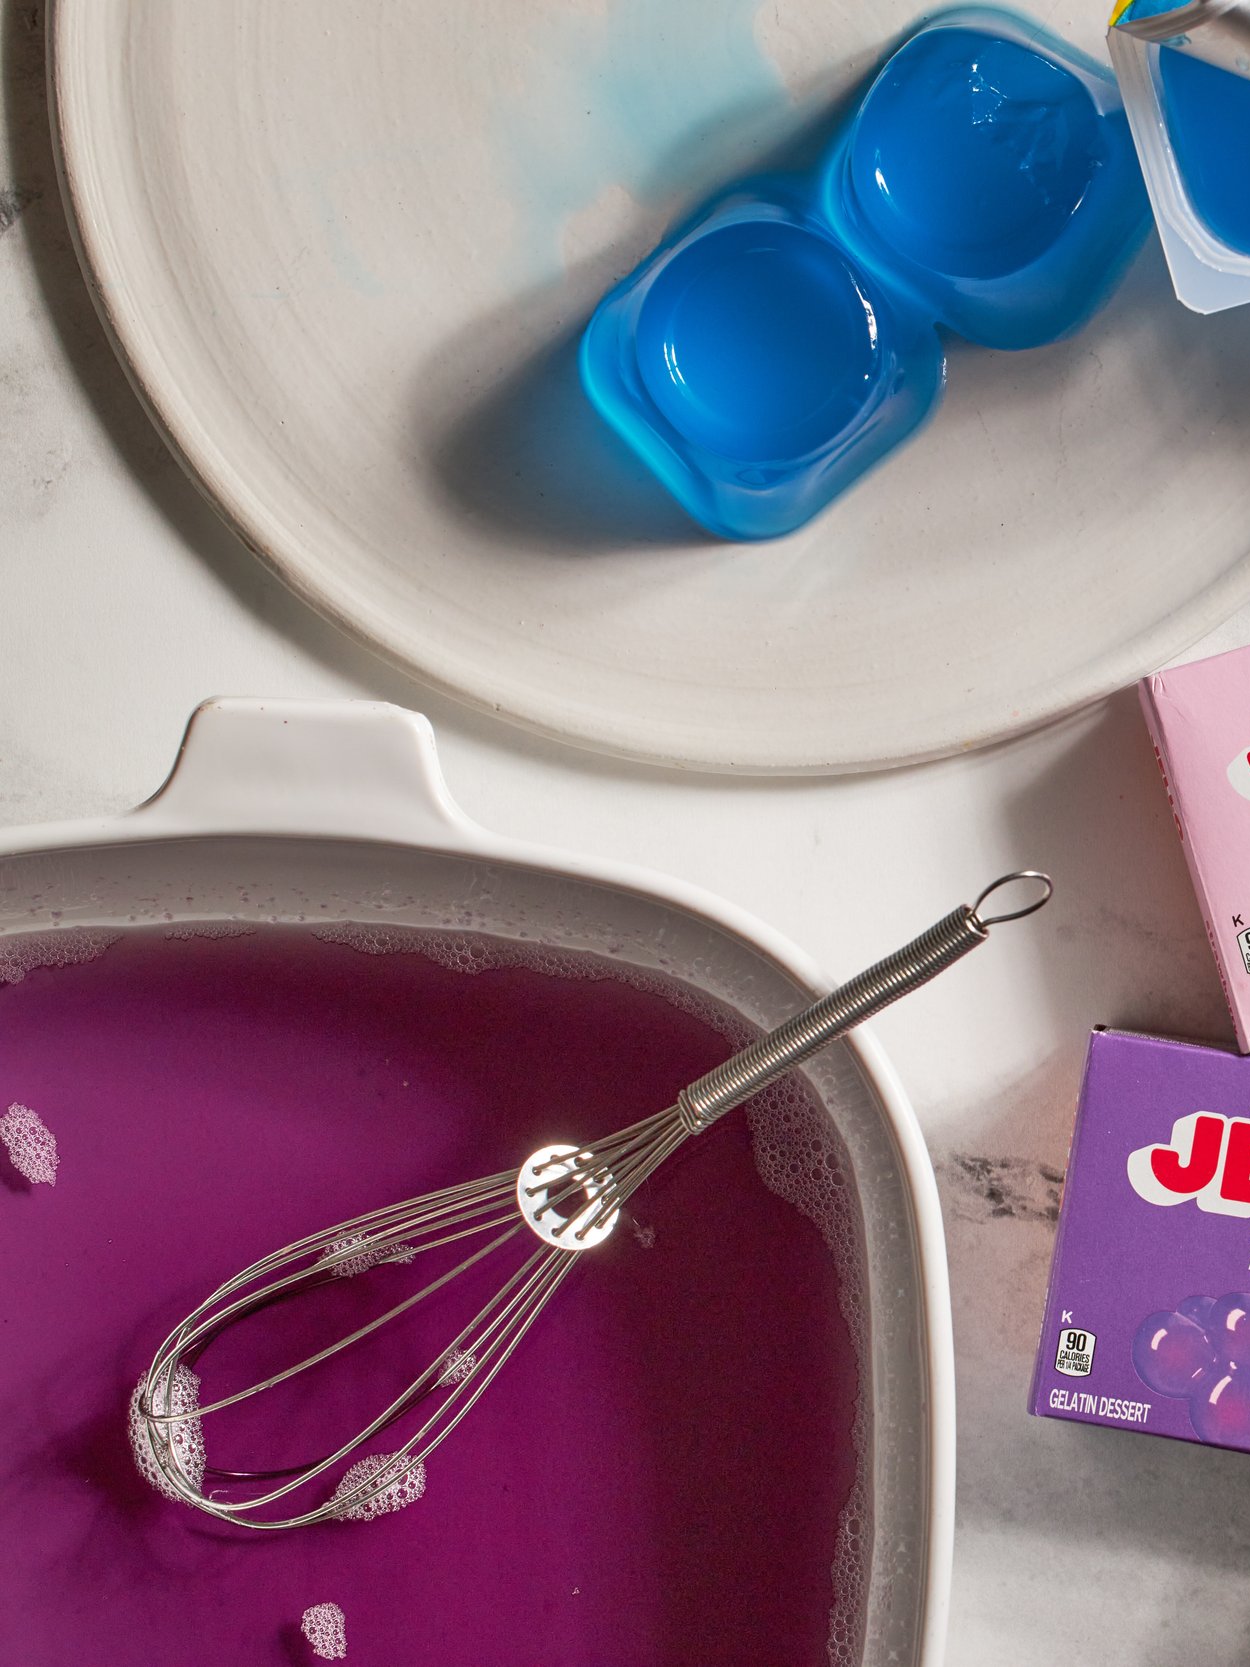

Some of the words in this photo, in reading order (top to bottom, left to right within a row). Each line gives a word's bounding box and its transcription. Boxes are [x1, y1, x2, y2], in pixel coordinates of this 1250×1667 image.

[1232, 914, 1244, 927] K
[1061, 1310, 1073, 1324] K
[1066, 1331, 1087, 1352] 90
[1059, 1350, 1090, 1364] CALORIES
[1057, 1359, 1065, 1368] PER
[1072, 1361, 1090, 1373] PACKAGE
[1049, 1388, 1098, 1415] GELATIN
[1098, 1397, 1152, 1424] DESSERT
